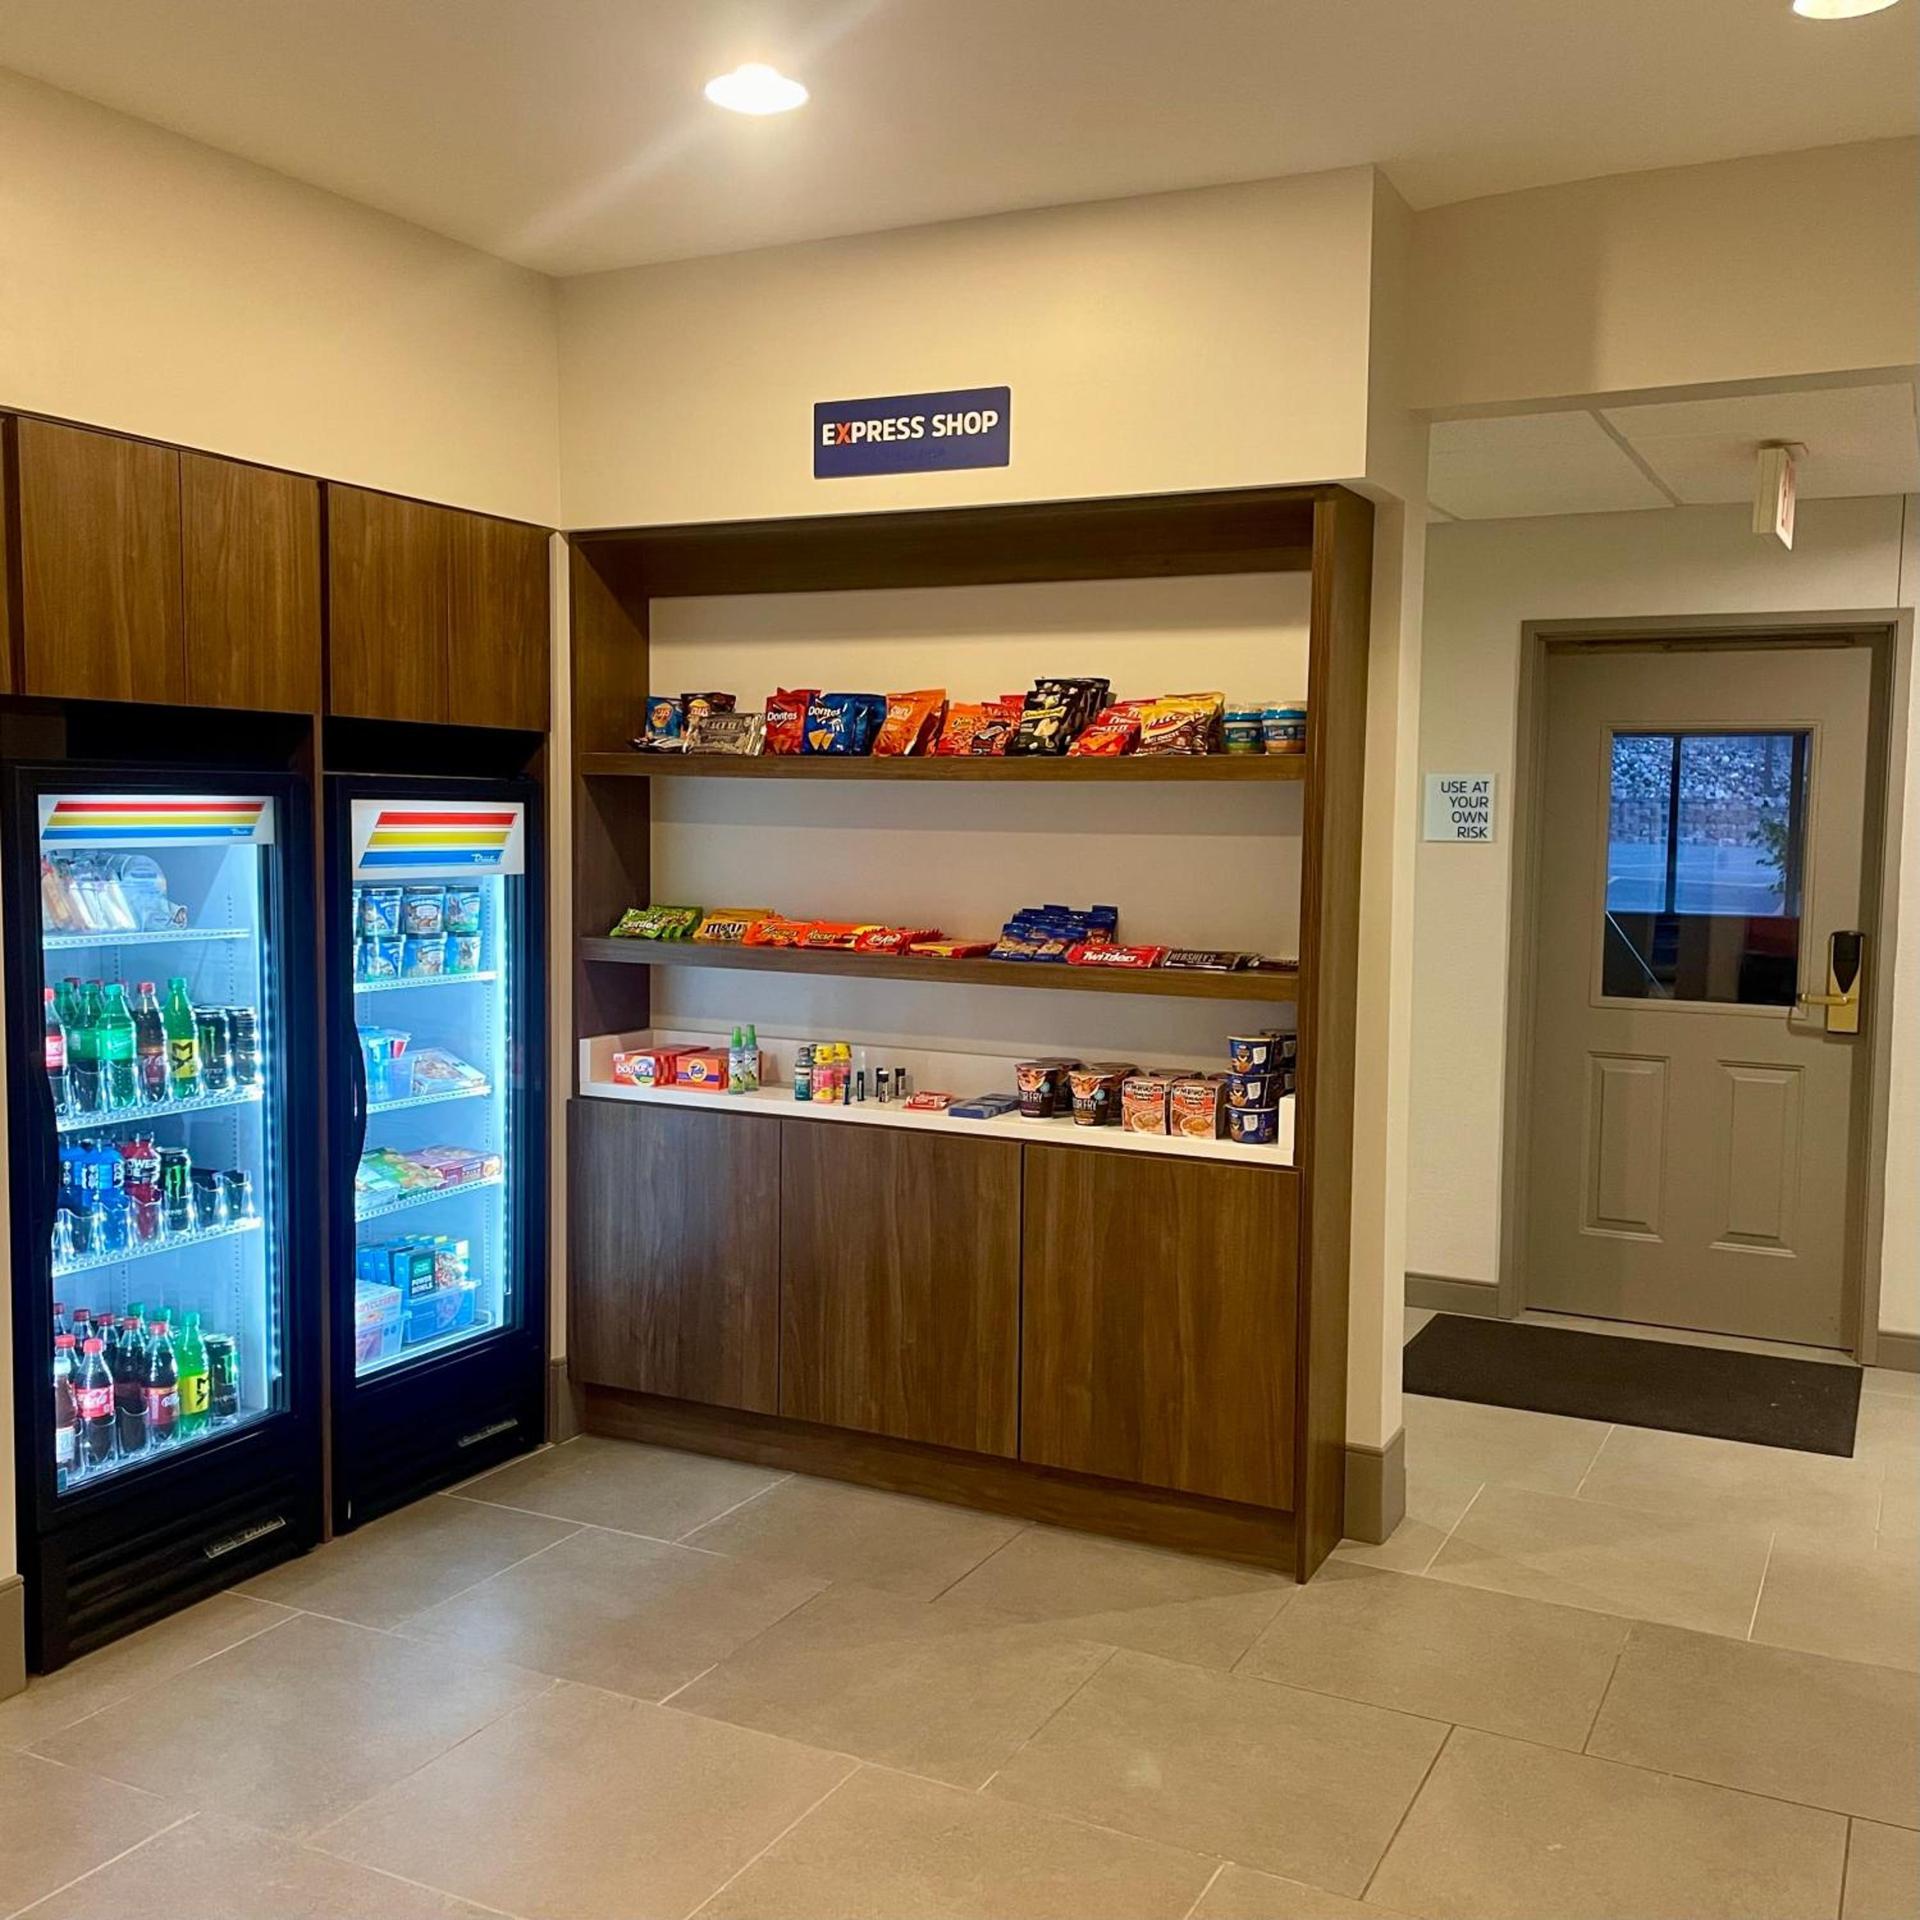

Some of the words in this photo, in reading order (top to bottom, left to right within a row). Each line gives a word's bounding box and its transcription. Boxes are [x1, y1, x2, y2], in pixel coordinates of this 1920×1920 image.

[822, 416, 926, 447] EXPRESS
[931, 410, 999, 437] SHOP
[1440, 781, 1468, 793] USE
[1472, 781, 1490, 793] AT
[1449, 796, 1489, 808] YOUR
[1451, 811, 1488, 823] OWN
[1457, 826, 1488, 838] RISK
